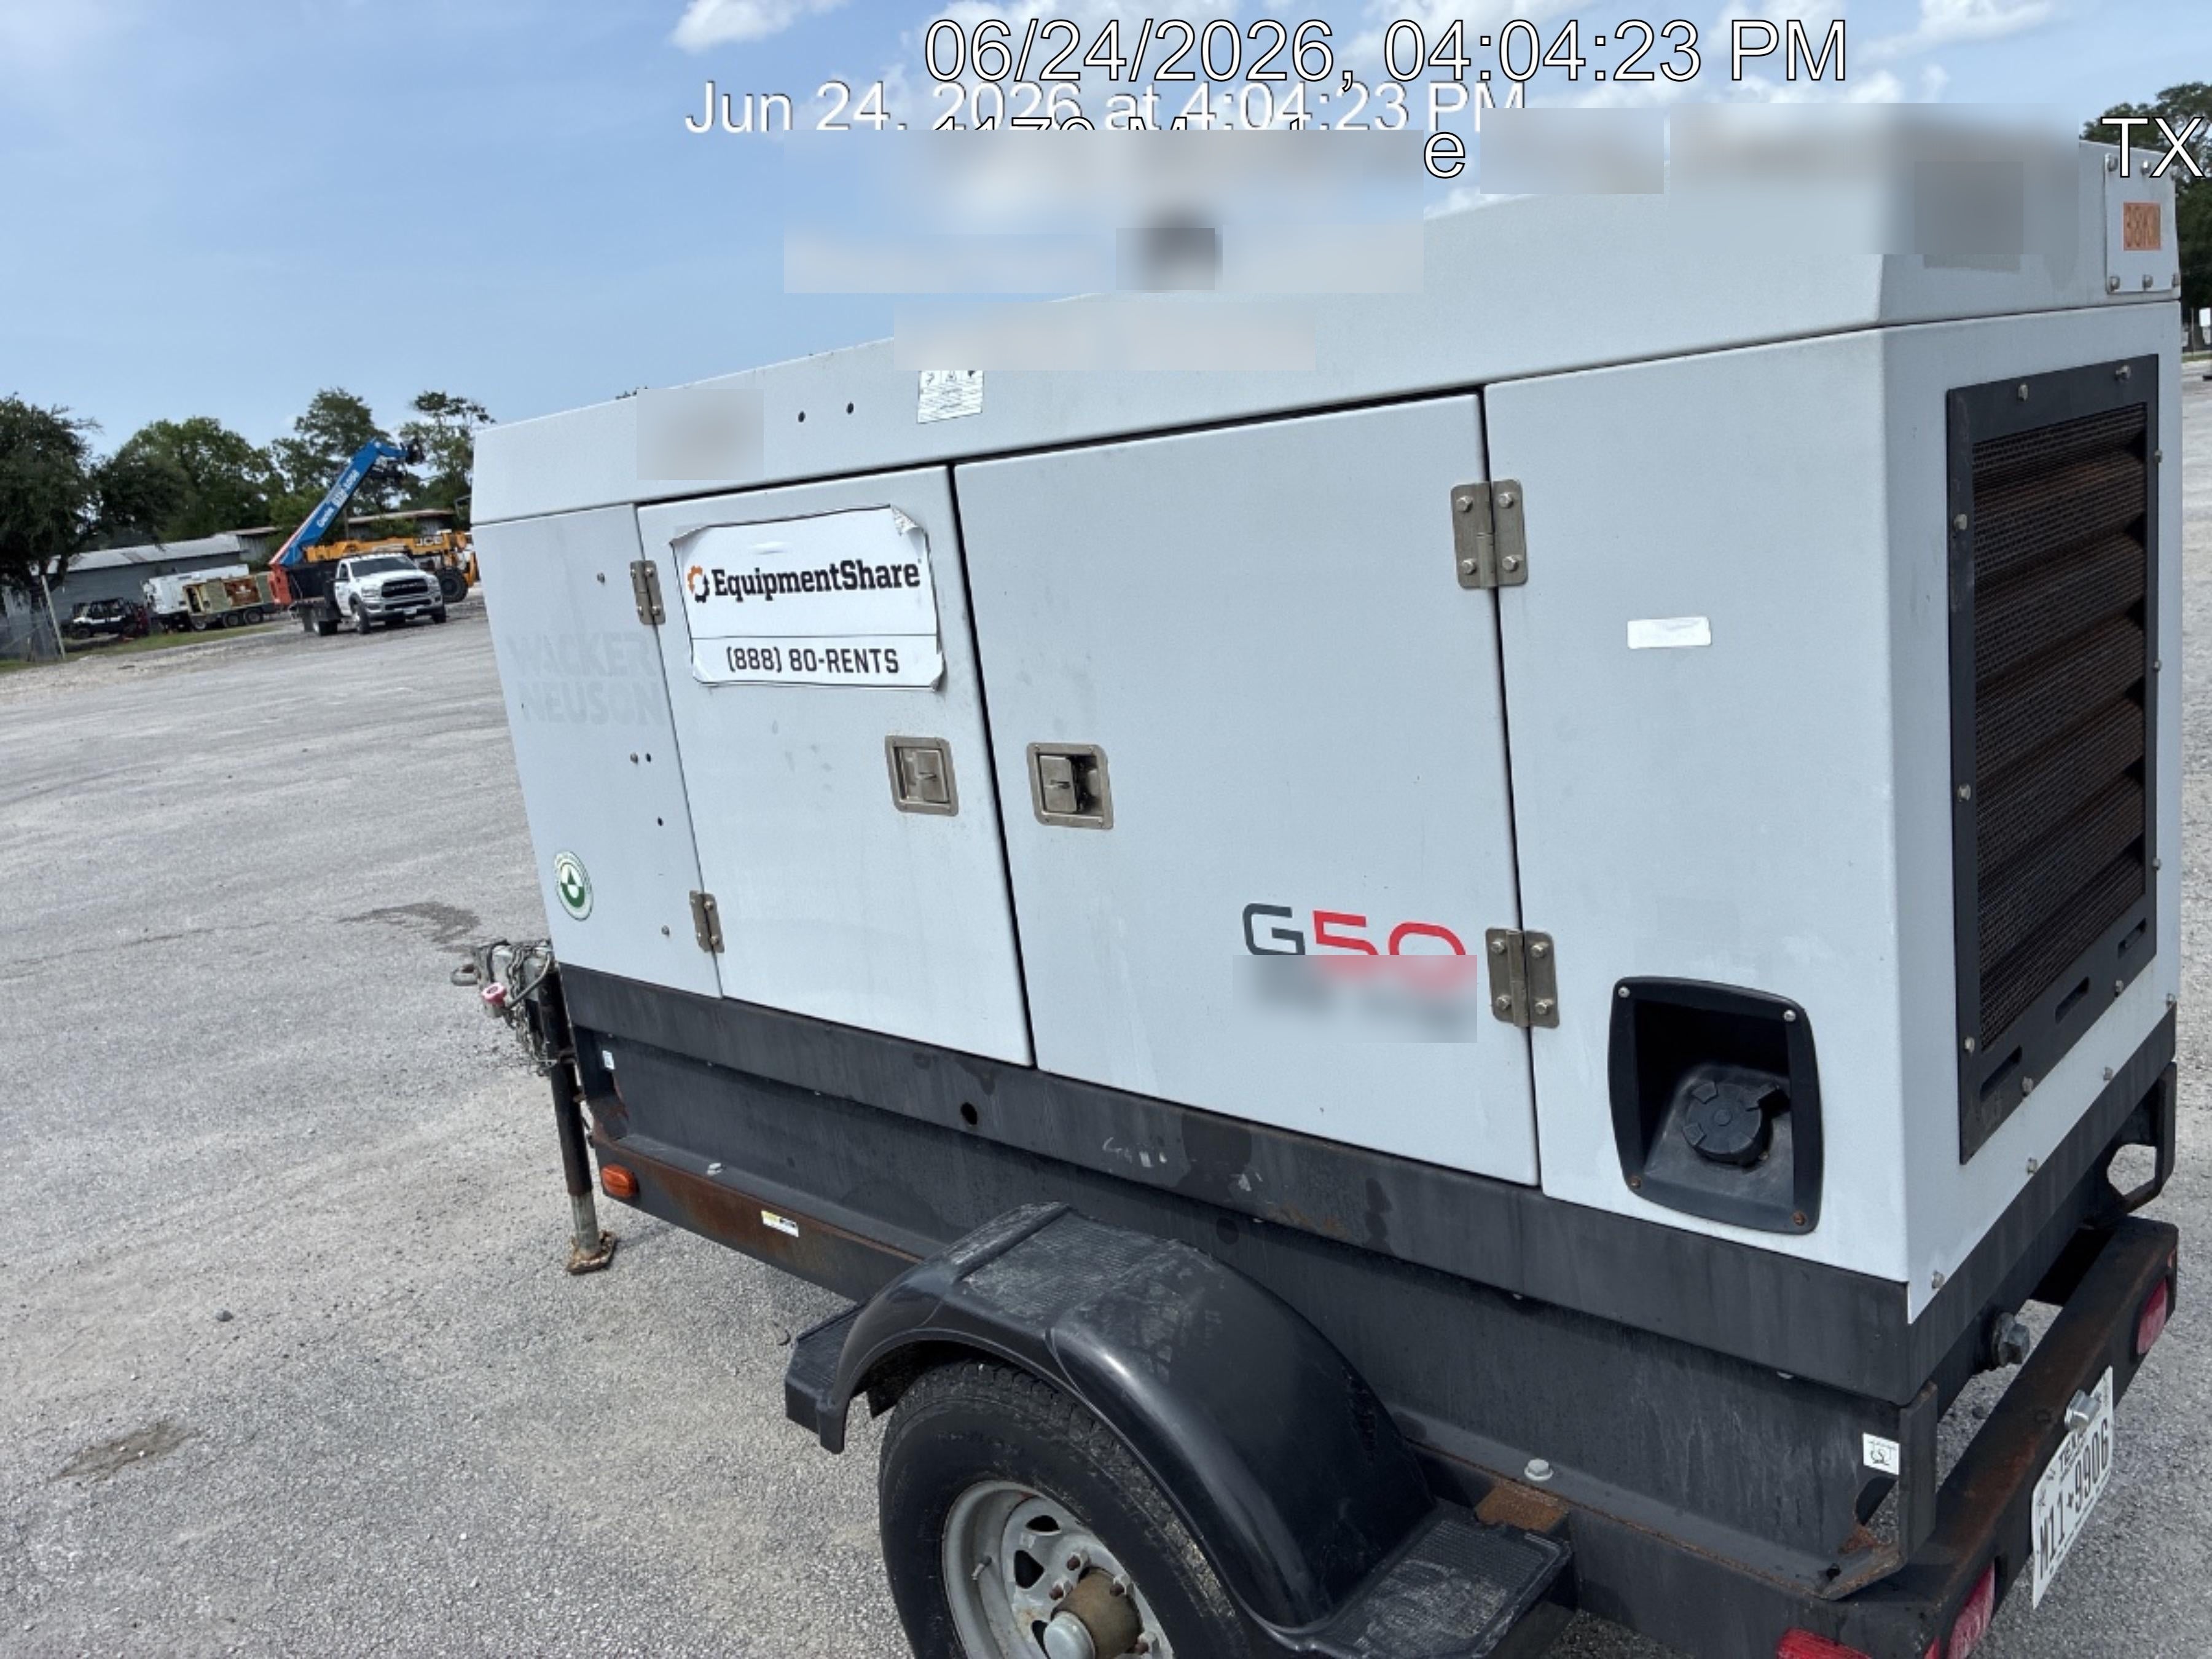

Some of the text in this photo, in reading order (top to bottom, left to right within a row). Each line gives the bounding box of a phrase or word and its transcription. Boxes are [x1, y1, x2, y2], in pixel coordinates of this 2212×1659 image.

[712, 559, 921, 603] EquipmentShare
[505, 632, 657, 677] WACKER
[726, 646, 900, 674] (888) 80-RENTS
[517, 681, 666, 726] NEUSON
